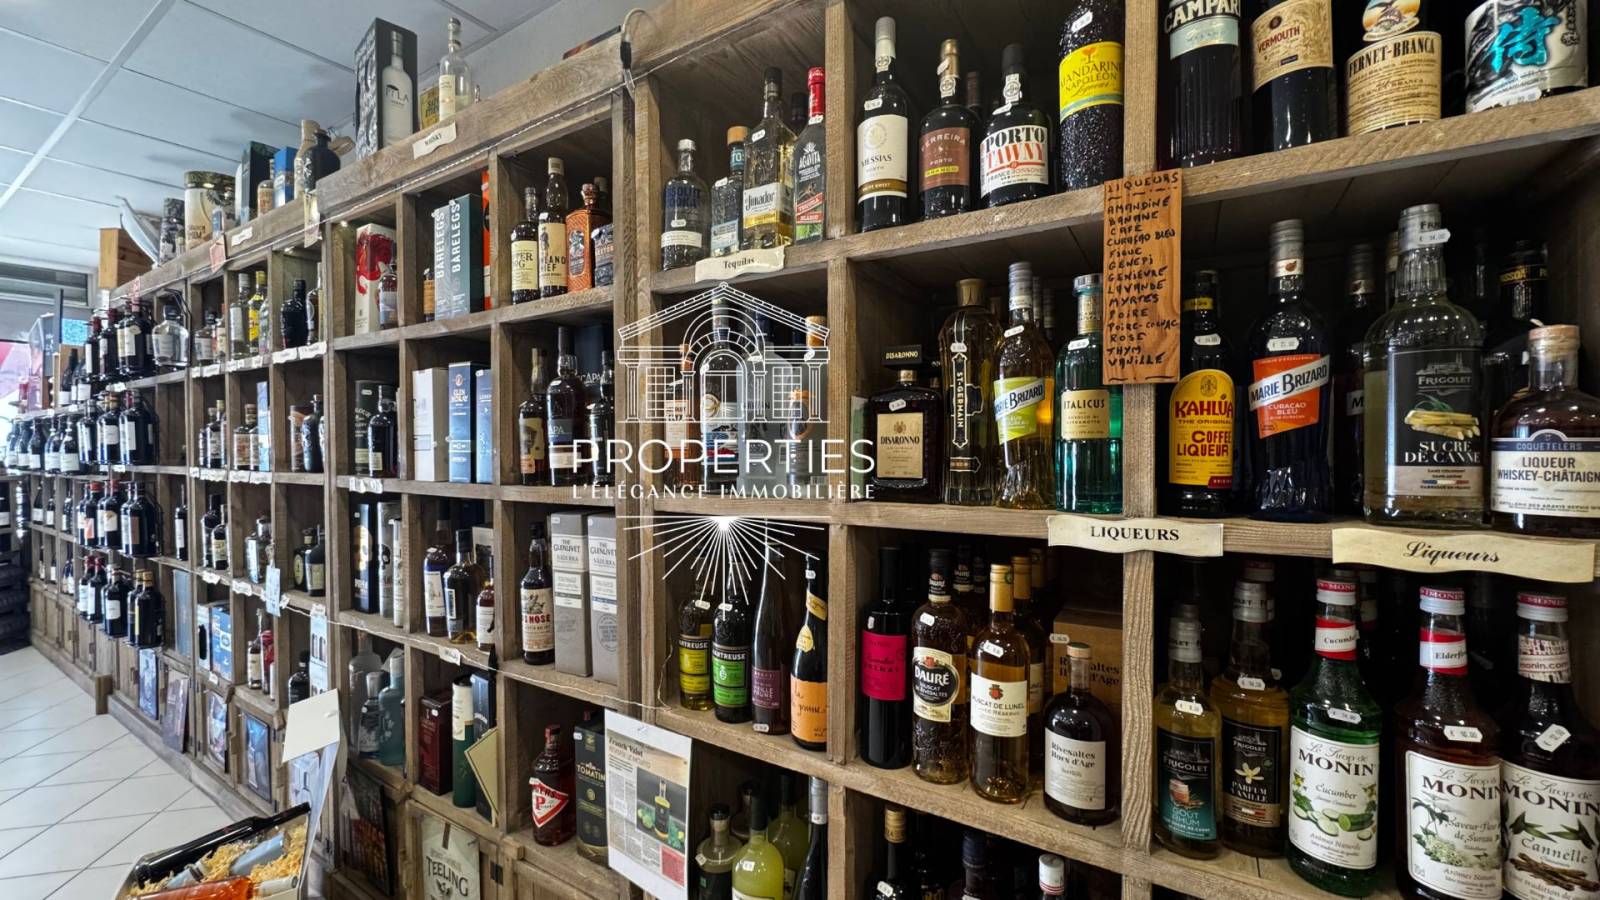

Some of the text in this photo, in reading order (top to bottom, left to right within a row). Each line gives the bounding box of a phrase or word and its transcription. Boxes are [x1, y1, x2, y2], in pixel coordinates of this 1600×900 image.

[1257, 26, 1300, 53] VERMOUTH
[1349, 38, 1436, 78] FERNET-BRANCA
[986, 127, 1045, 153] PORTO
[988, 142, 1044, 169] TAWNY
[1108, 172, 1178, 192] LIQUEURS
[724, 257, 755, 269] Tequilas
[885, 351, 919, 360] DISARONNO
[1250, 364, 1328, 403] MARIE BRIZARD
[1417, 375, 1473, 386] FRIGOLET
[956, 371, 965, 429] ST-GERMAIN
[1009, 383, 1044, 410] BRIZARD
[1064, 399, 1105, 409] ITALICUS
[880, 436, 920, 445] DISARONNO
[1192, 430, 1232, 444] COFFEE
[1419, 441, 1473, 453] SUCRE
[1177, 443, 1229, 458] LIQUEUR
[1404, 452, 1482, 464] DE CANNE
[1522, 456, 1576, 469] LIQUEUR
[1091, 525, 1180, 542] LIQUEURS
[1403, 540, 1501, 566] Liqueurs
[914, 665, 949, 686] DAURÉ
[1051, 741, 1096, 759] Rivesaltes
[1299, 748, 1374, 777] MONIN
[1315, 783, 1358, 801] Cucumber
[1502, 780, 1600, 817] MONIN
[1521, 837, 1589, 864] Cannelle
[426, 855, 469, 897] TEELING
